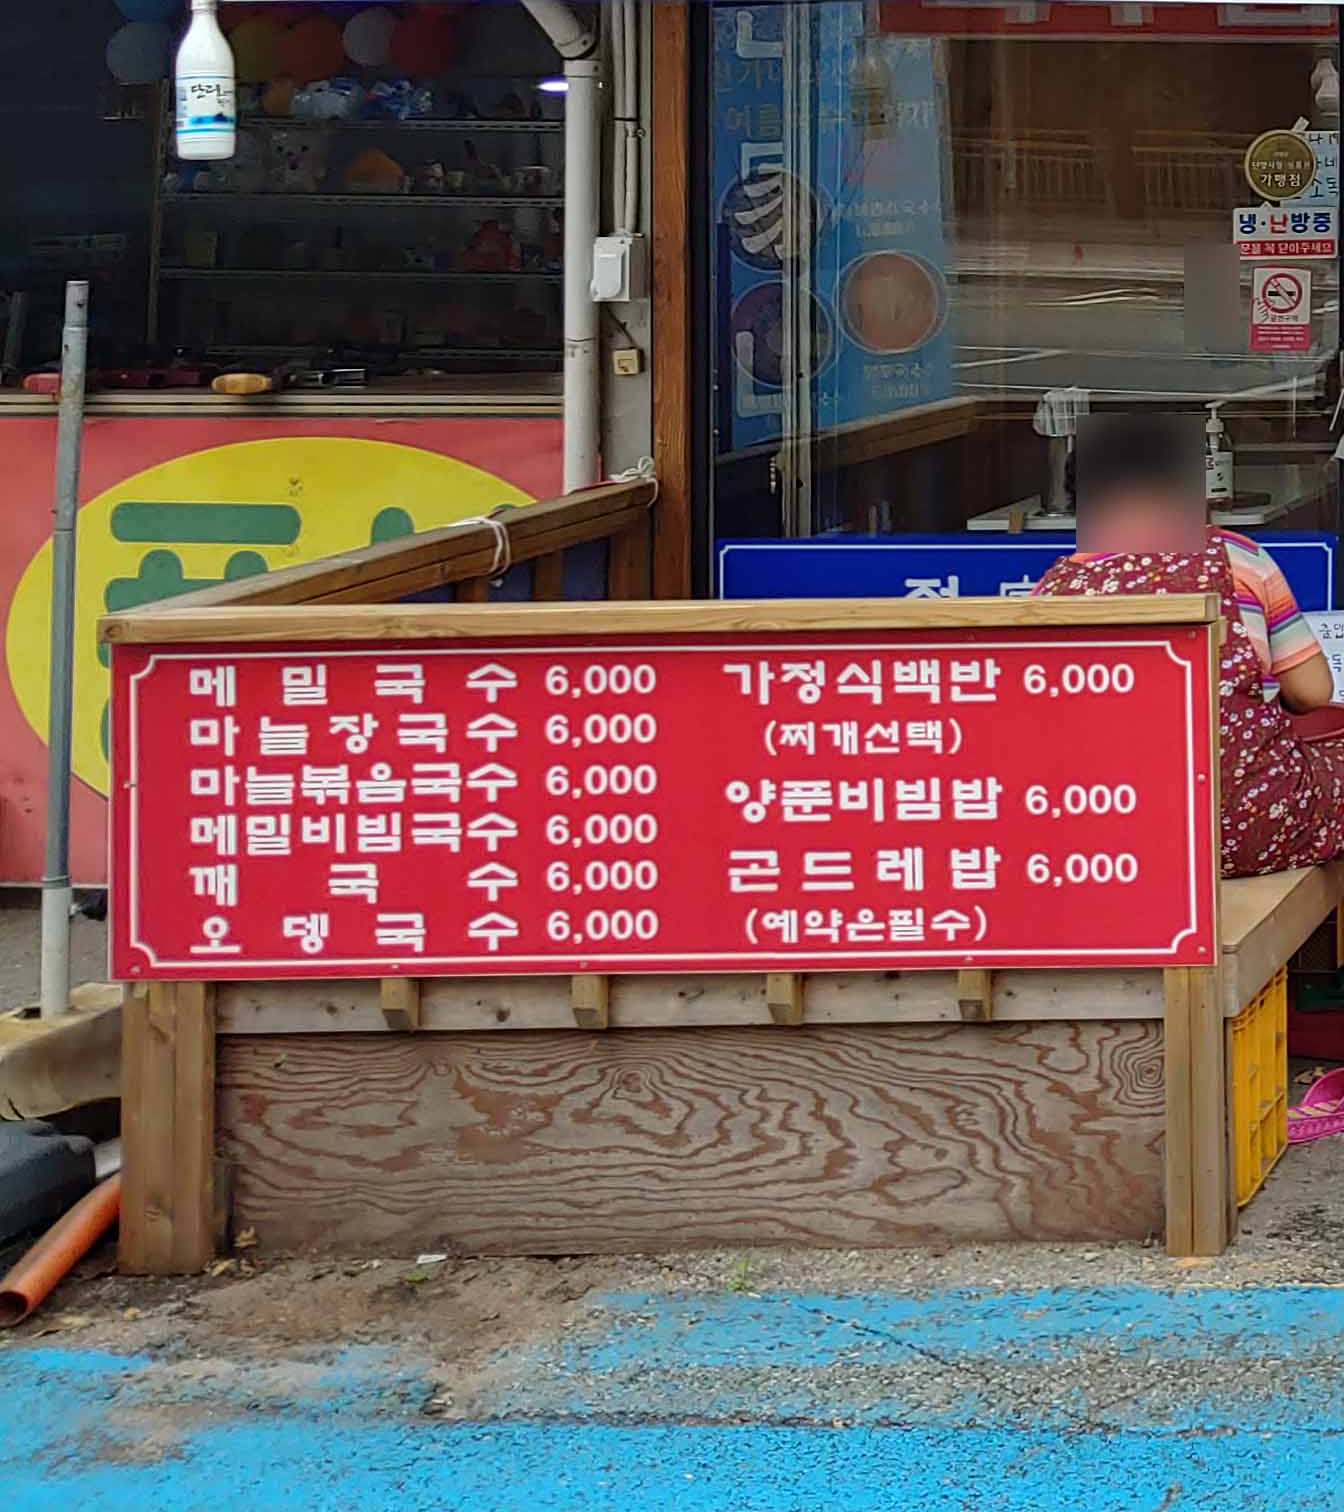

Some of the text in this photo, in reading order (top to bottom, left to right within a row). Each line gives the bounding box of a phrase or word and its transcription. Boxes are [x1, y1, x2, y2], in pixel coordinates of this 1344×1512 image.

[1259, 172, 1301, 188] 가맹점
[545, 664, 657, 699] 6,000
[723, 657, 1135, 706] 가정식백반 6,000
[545, 713, 657, 749] 6,000
[764, 718, 962, 756] (찌개선택)
[189, 762, 658, 806] 마늘볶음국수 6,000
[725, 776, 1137, 823] 양푼비빔밥 6,000
[189, 811, 658, 856] 메밀비빔국수 6,000
[546, 859, 658, 895] 6,000
[1025, 852, 1138, 887] 6,000
[546, 909, 659, 945] 6,000
[745, 904, 987, 944] (예약은필수)
